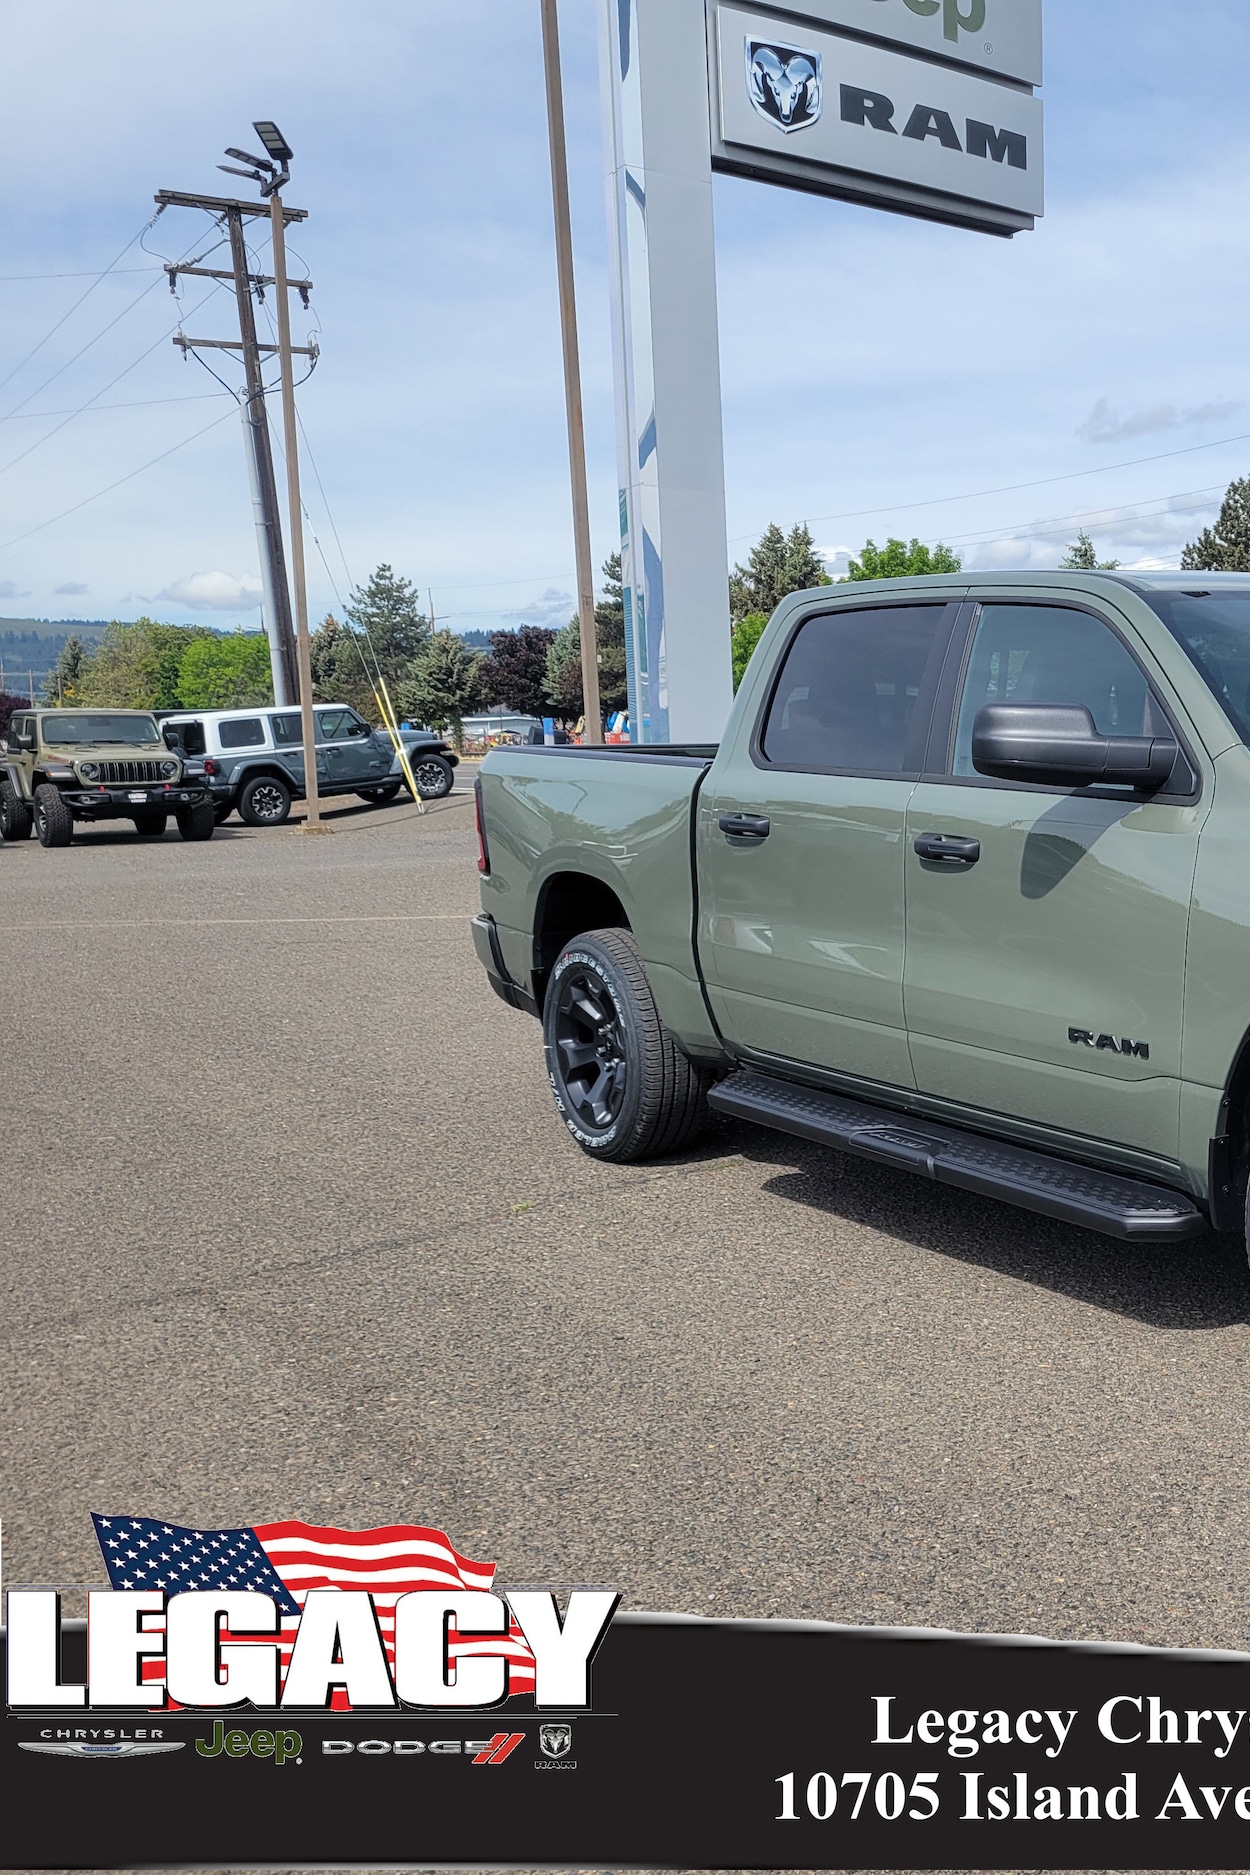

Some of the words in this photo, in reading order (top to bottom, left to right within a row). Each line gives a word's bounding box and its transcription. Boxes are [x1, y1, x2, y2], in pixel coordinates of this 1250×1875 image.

[840, 83, 1027, 171] RAM
[554, 952, 626, 1029] BRIDGESTONE
[1068, 1026, 1150, 1061] RAM
[566, 1118, 617, 1147] DUELER
